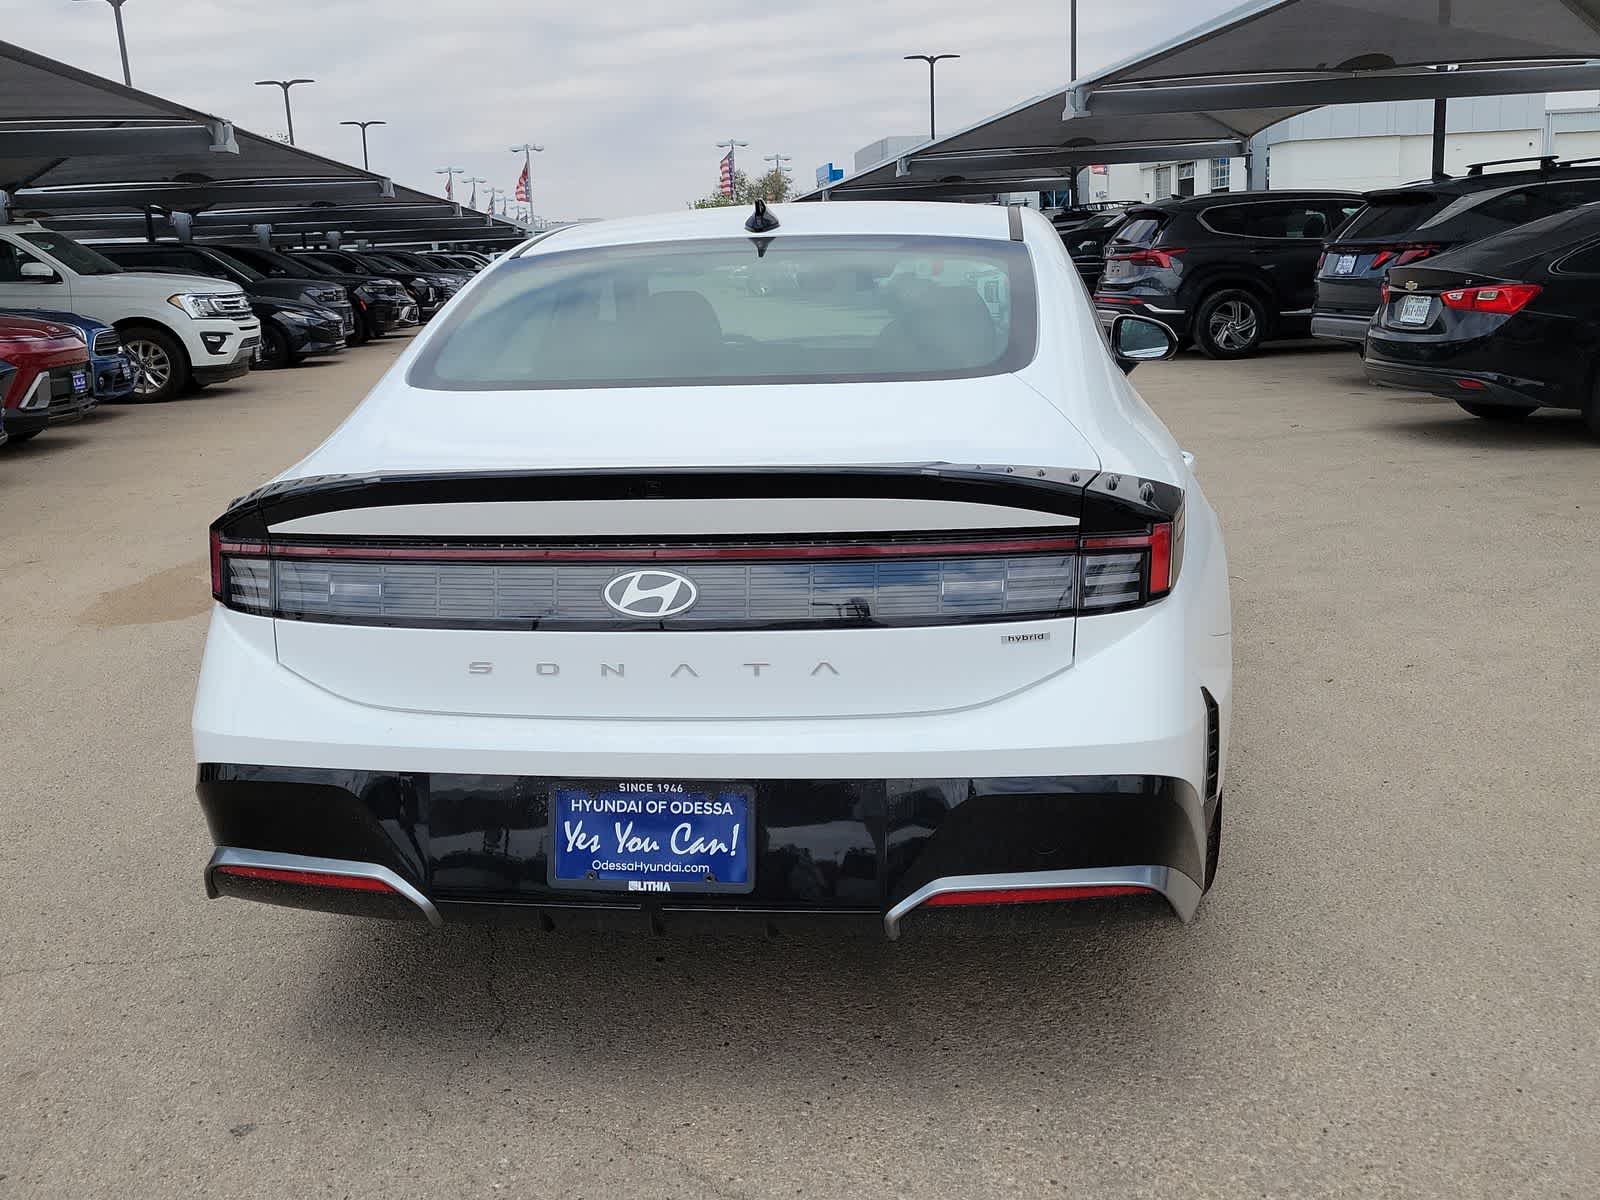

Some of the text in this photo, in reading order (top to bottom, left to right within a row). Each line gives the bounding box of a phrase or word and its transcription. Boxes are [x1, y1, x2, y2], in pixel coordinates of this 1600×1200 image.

[1008, 633, 1044, 642] hybrid
[468, 661, 840, 678] SONATA
[619, 783, 683, 793] SINCE 1946
[571, 799, 734, 815] HYUNDAI OF ODESSA
[564, 820, 740, 857] Yes You Can!
[591, 860, 710, 874] OdessaHyundai.com
[638, 881, 671, 892] LITHIA
